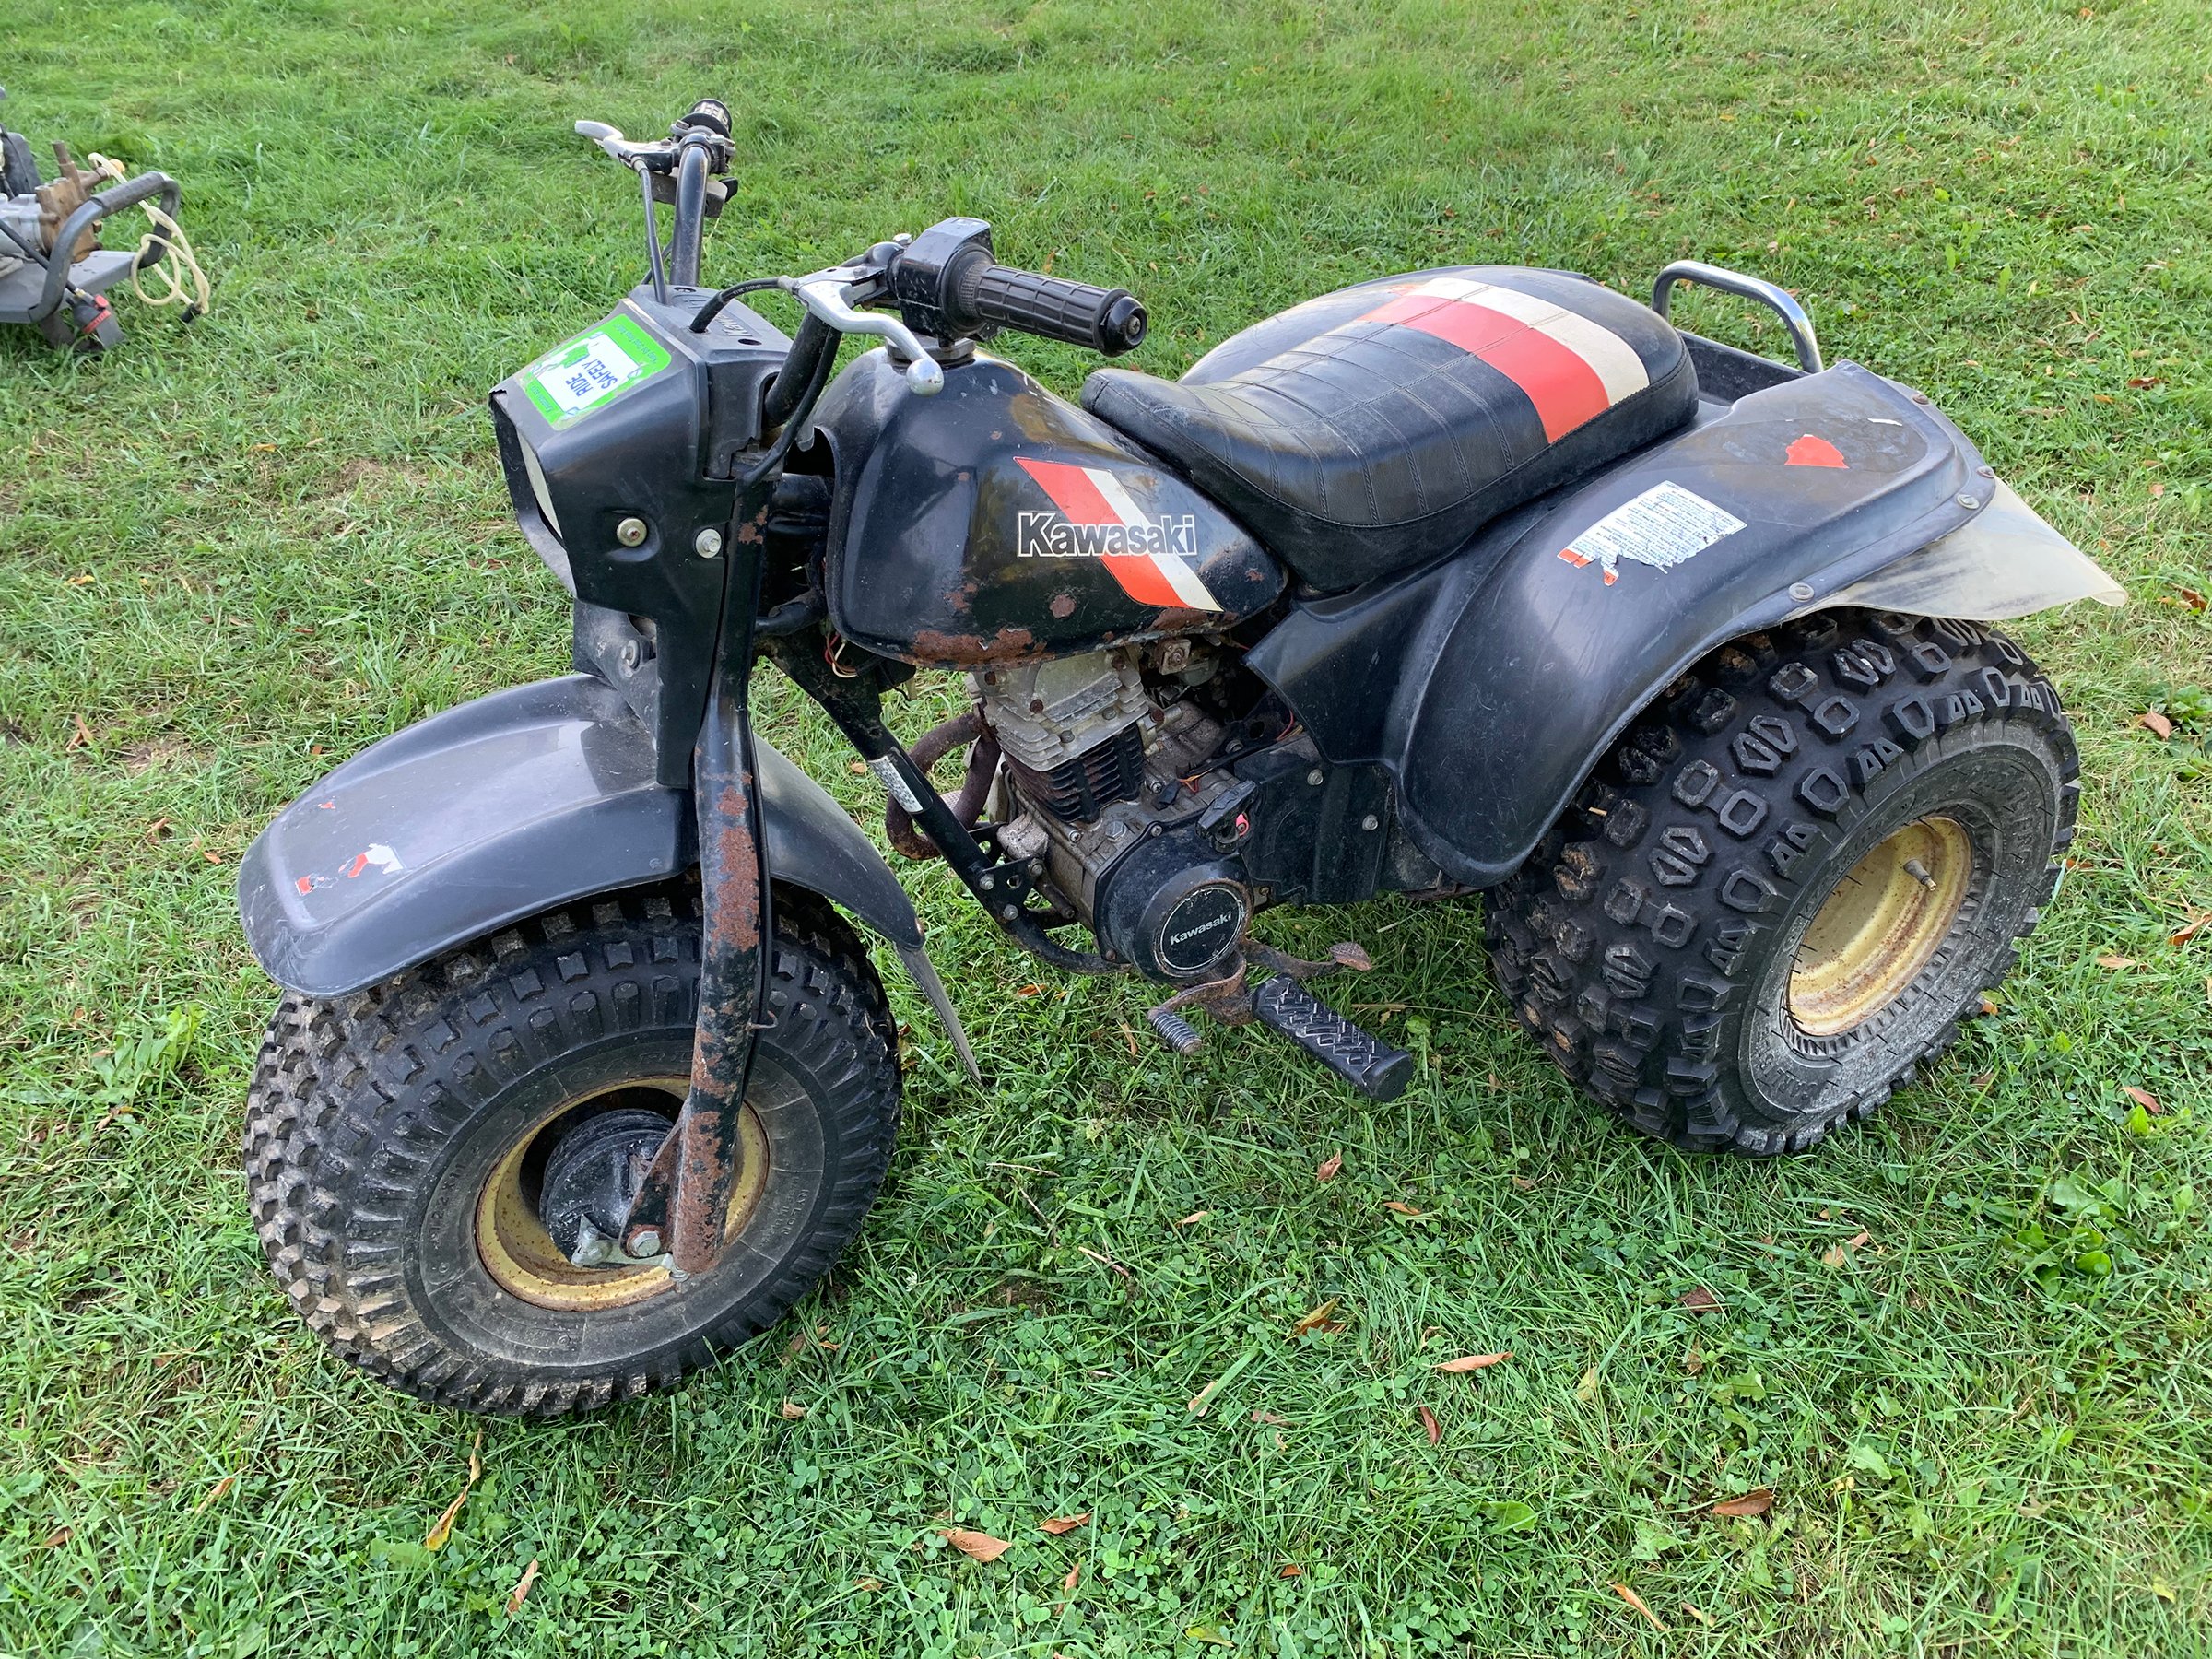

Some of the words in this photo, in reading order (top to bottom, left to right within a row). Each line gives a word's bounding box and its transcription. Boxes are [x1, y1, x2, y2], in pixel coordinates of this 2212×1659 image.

[565, 372, 594, 397] RIDE
[582, 359, 618, 390] SAFELY
[1018, 512, 1198, 557] Kawasaki
[1170, 911, 1233, 946] Kawasaki
